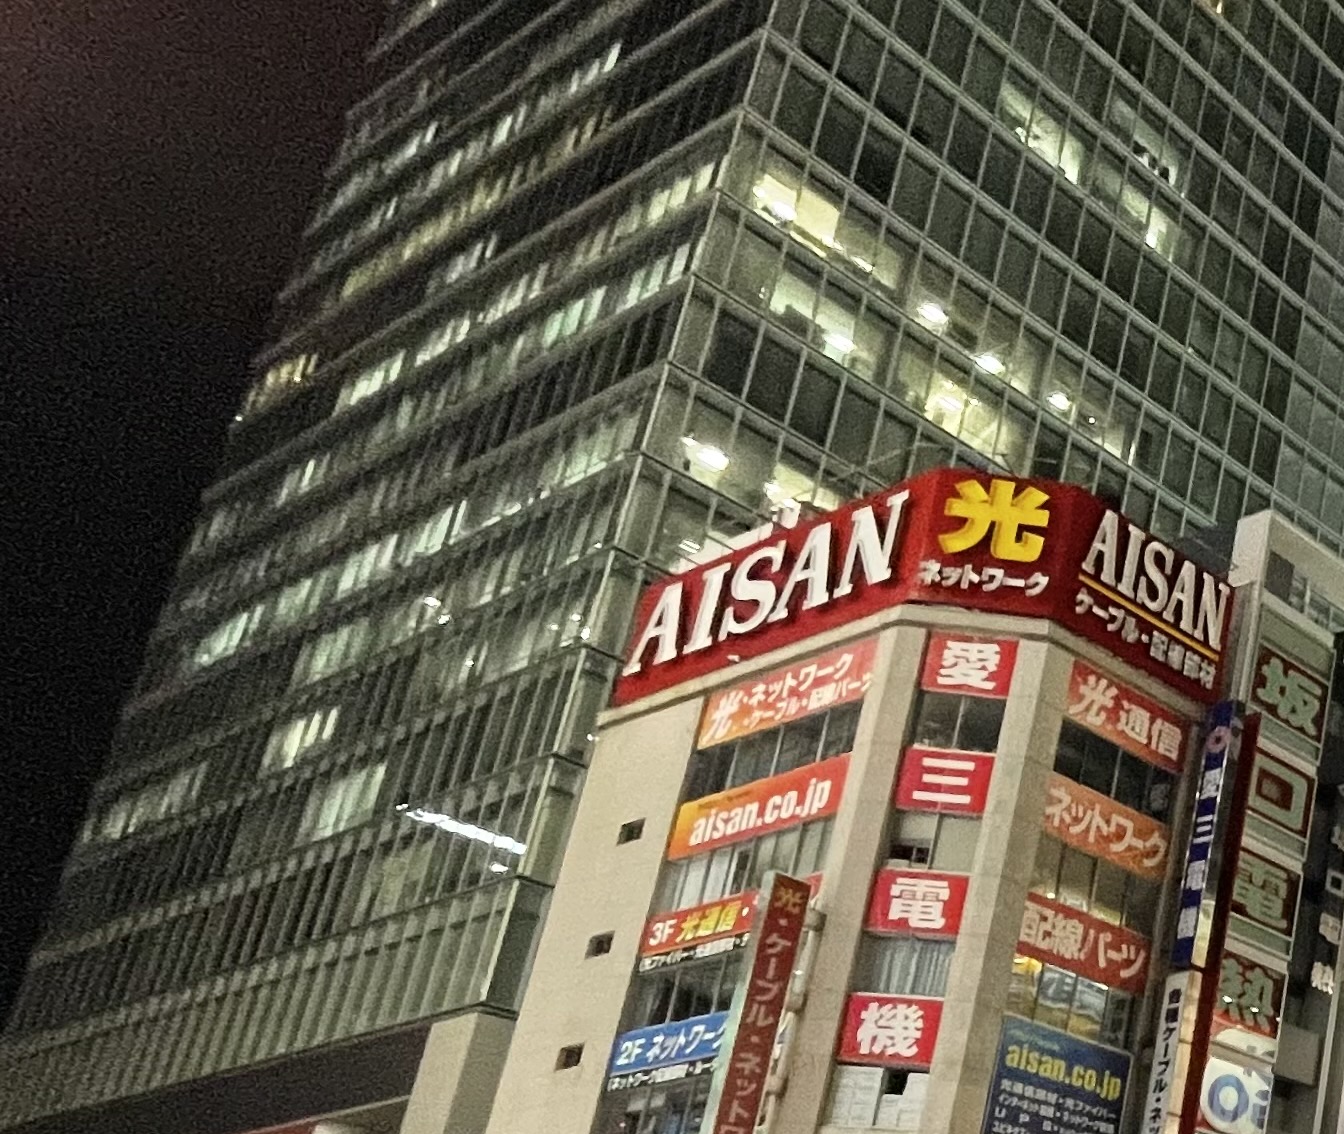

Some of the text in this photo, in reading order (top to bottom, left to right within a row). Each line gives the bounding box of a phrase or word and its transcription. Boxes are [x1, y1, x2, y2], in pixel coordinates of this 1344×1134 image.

[936, 477, 1051, 563] 光
[623, 489, 911, 677] AISAN
[918, 559, 1051, 597] ネットワーク
[1081, 509, 1232, 652] AISAN
[935, 640, 1002, 690] 愛
[911, 759, 976, 805] 三
[688, 777, 833, 847] aisan.co.jp
[1043, 784, 1169, 868] ネットワーク
[887, 876, 951, 930] 電
[648, 918, 678, 946] 3F
[615, 1037, 647, 1066] 2F
[856, 1003, 925, 1058] 機
[1005, 1043, 1123, 1102] aisan.co.jp
